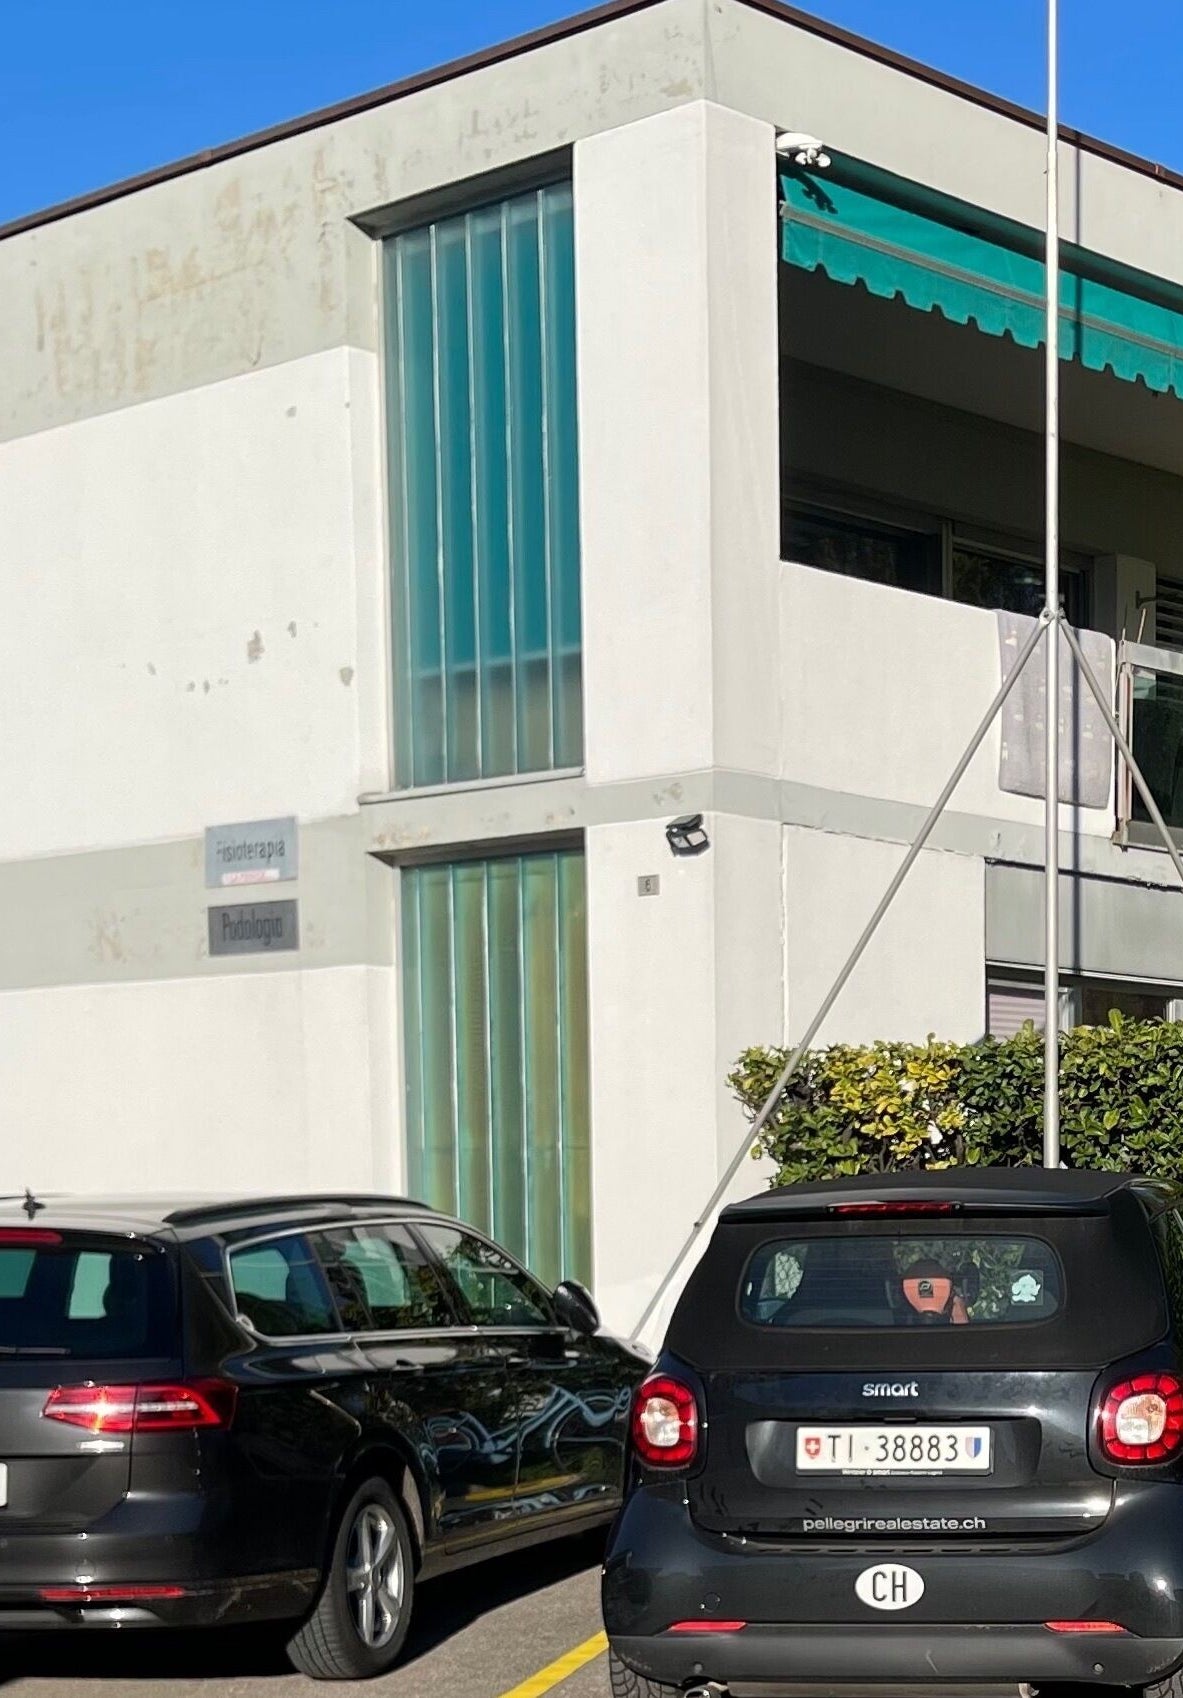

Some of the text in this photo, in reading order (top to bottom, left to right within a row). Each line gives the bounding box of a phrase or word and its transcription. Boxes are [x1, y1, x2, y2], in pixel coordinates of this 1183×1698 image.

[216, 838, 286, 867] Fisioterapia
[862, 1381, 919, 1397] smart
[827, 1434, 959, 1463] TI 38883
[802, 1516, 987, 1533] pellegrirealestate.ch
[871, 1570, 908, 1602] CH
